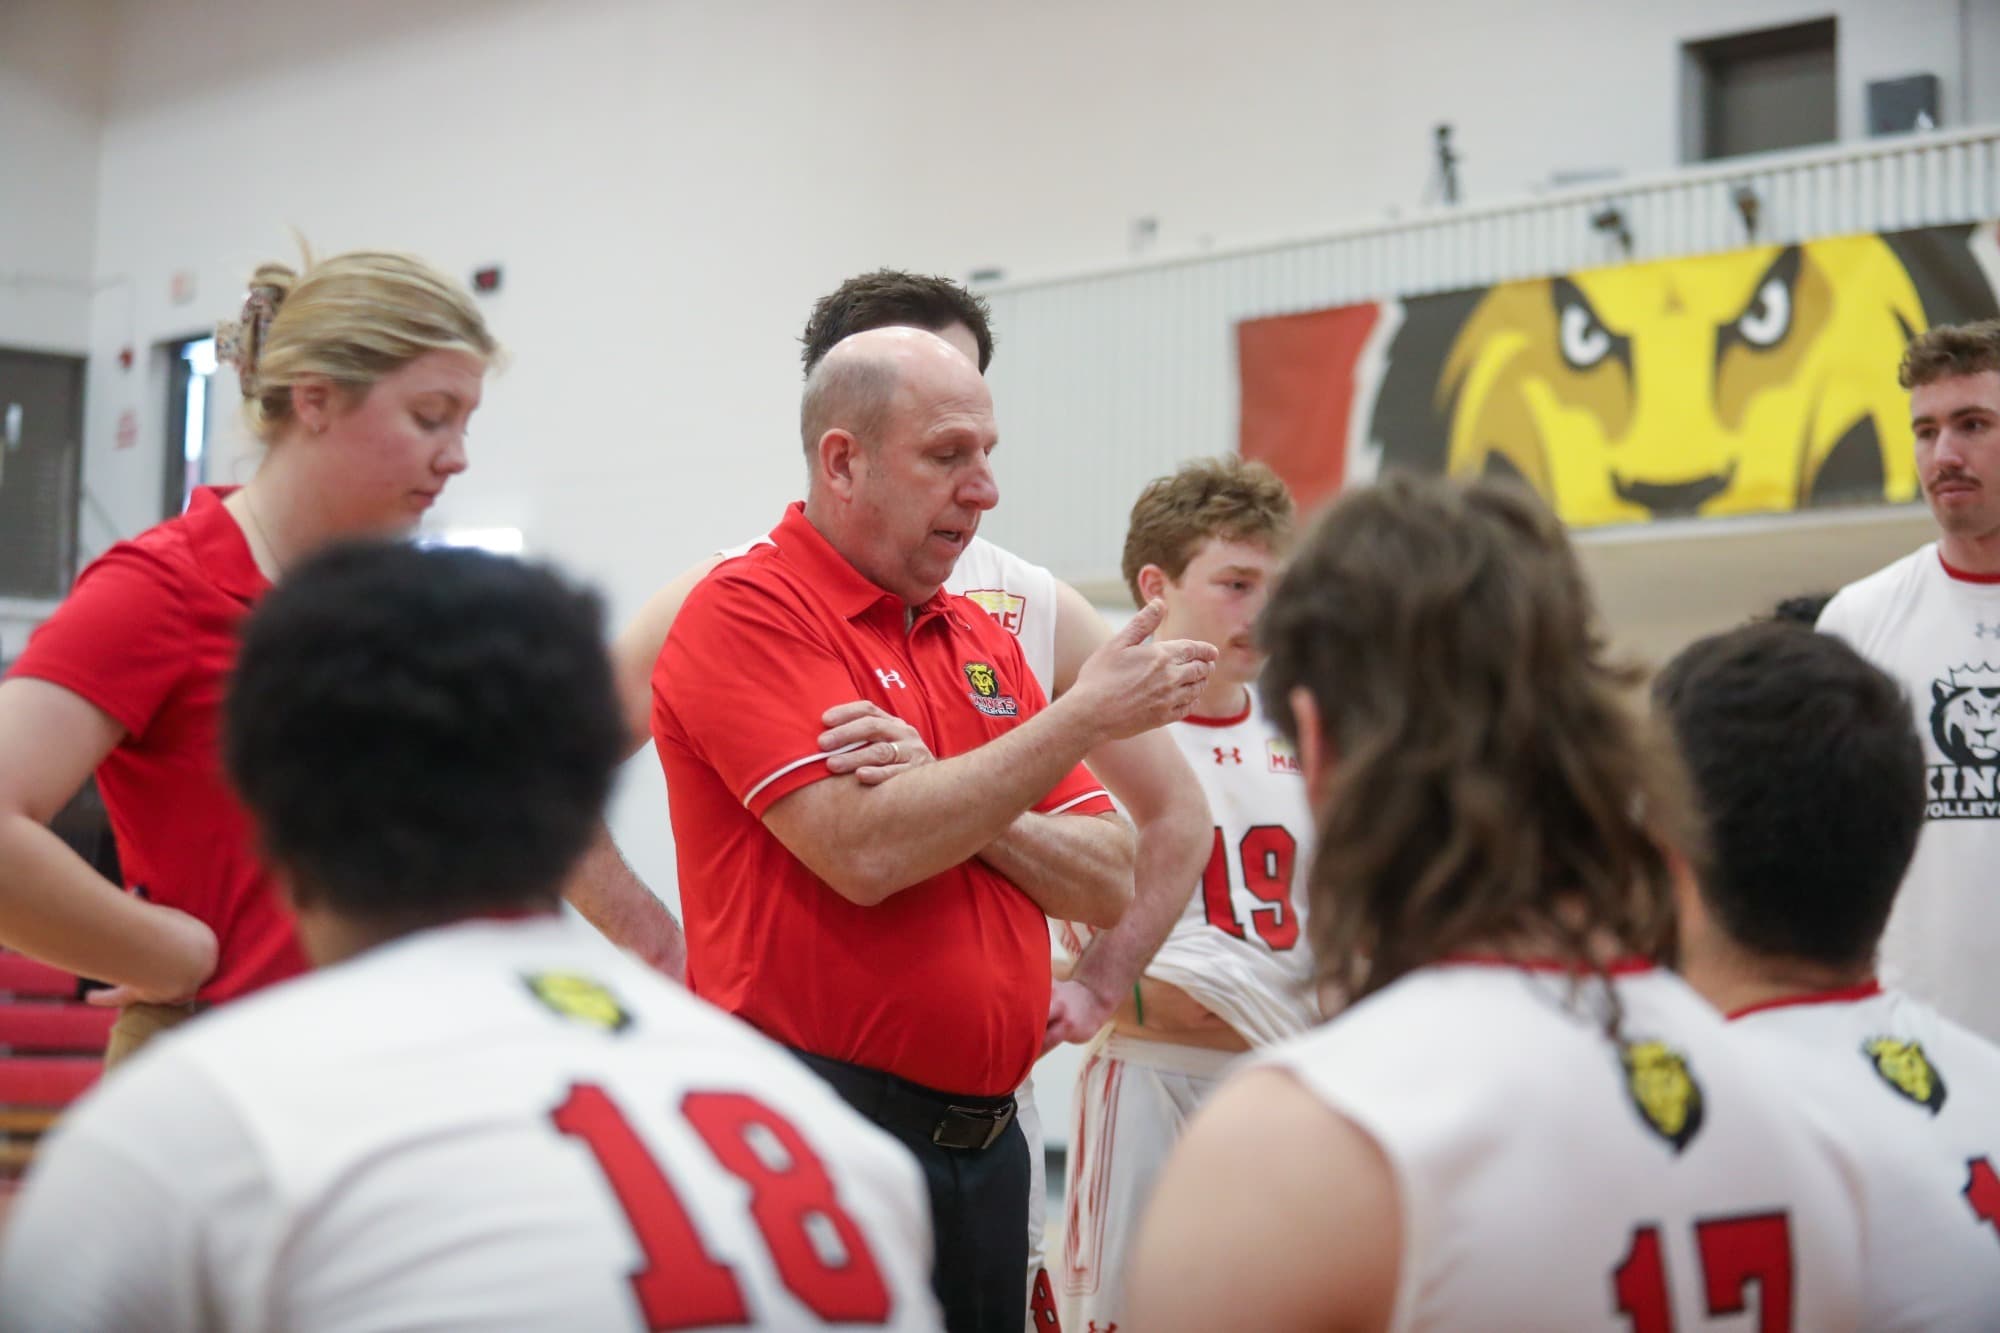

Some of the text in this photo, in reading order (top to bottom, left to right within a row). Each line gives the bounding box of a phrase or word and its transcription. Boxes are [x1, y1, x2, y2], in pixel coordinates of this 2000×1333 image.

[1926, 766, 2000, 799] KIN
[1203, 824, 1300, 951] 19
[550, 1083, 892, 1333] 18
[1613, 1209, 1794, 1333] 17
